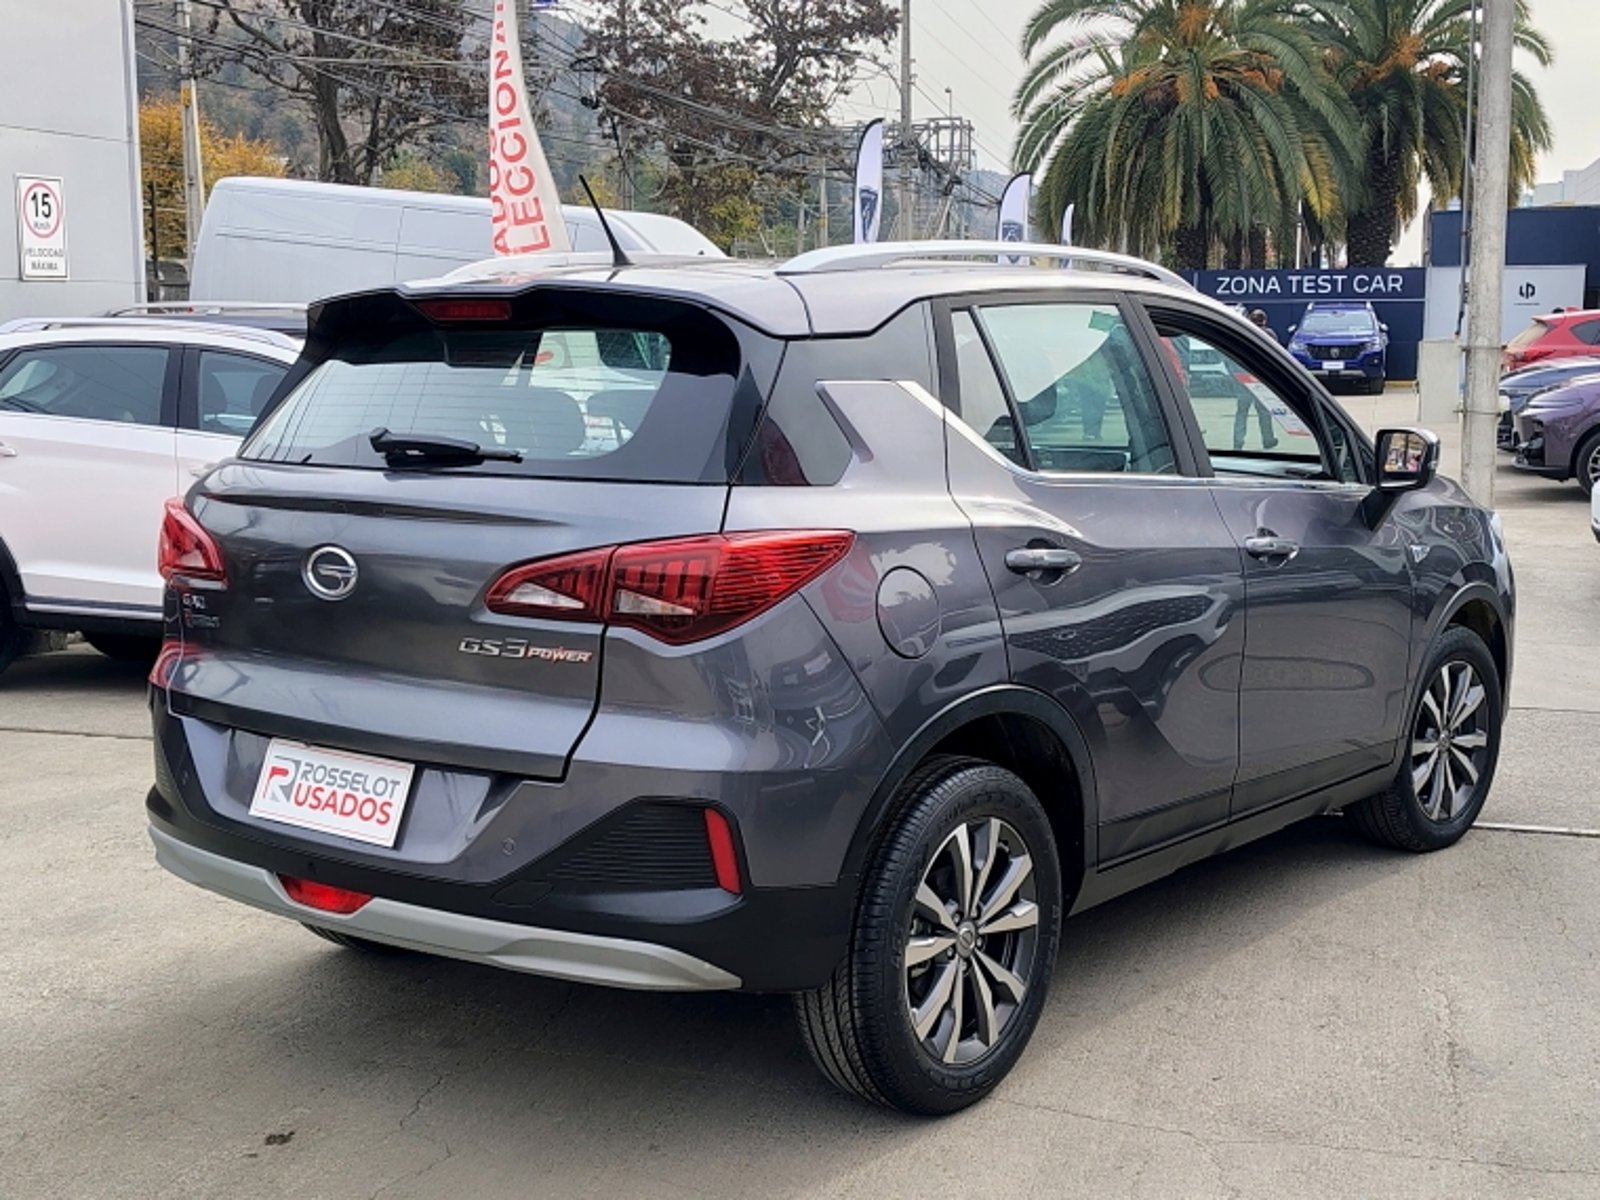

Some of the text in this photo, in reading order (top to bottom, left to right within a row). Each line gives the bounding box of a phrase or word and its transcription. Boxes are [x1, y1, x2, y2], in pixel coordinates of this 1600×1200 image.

[31, 191, 52, 219] 15
[1216, 274, 1404, 294] ZONA TEST CAR
[527, 646, 592, 664] POWER
[300, 762, 401, 799] ROSSELOT
[294, 783, 393, 825] USADOS
